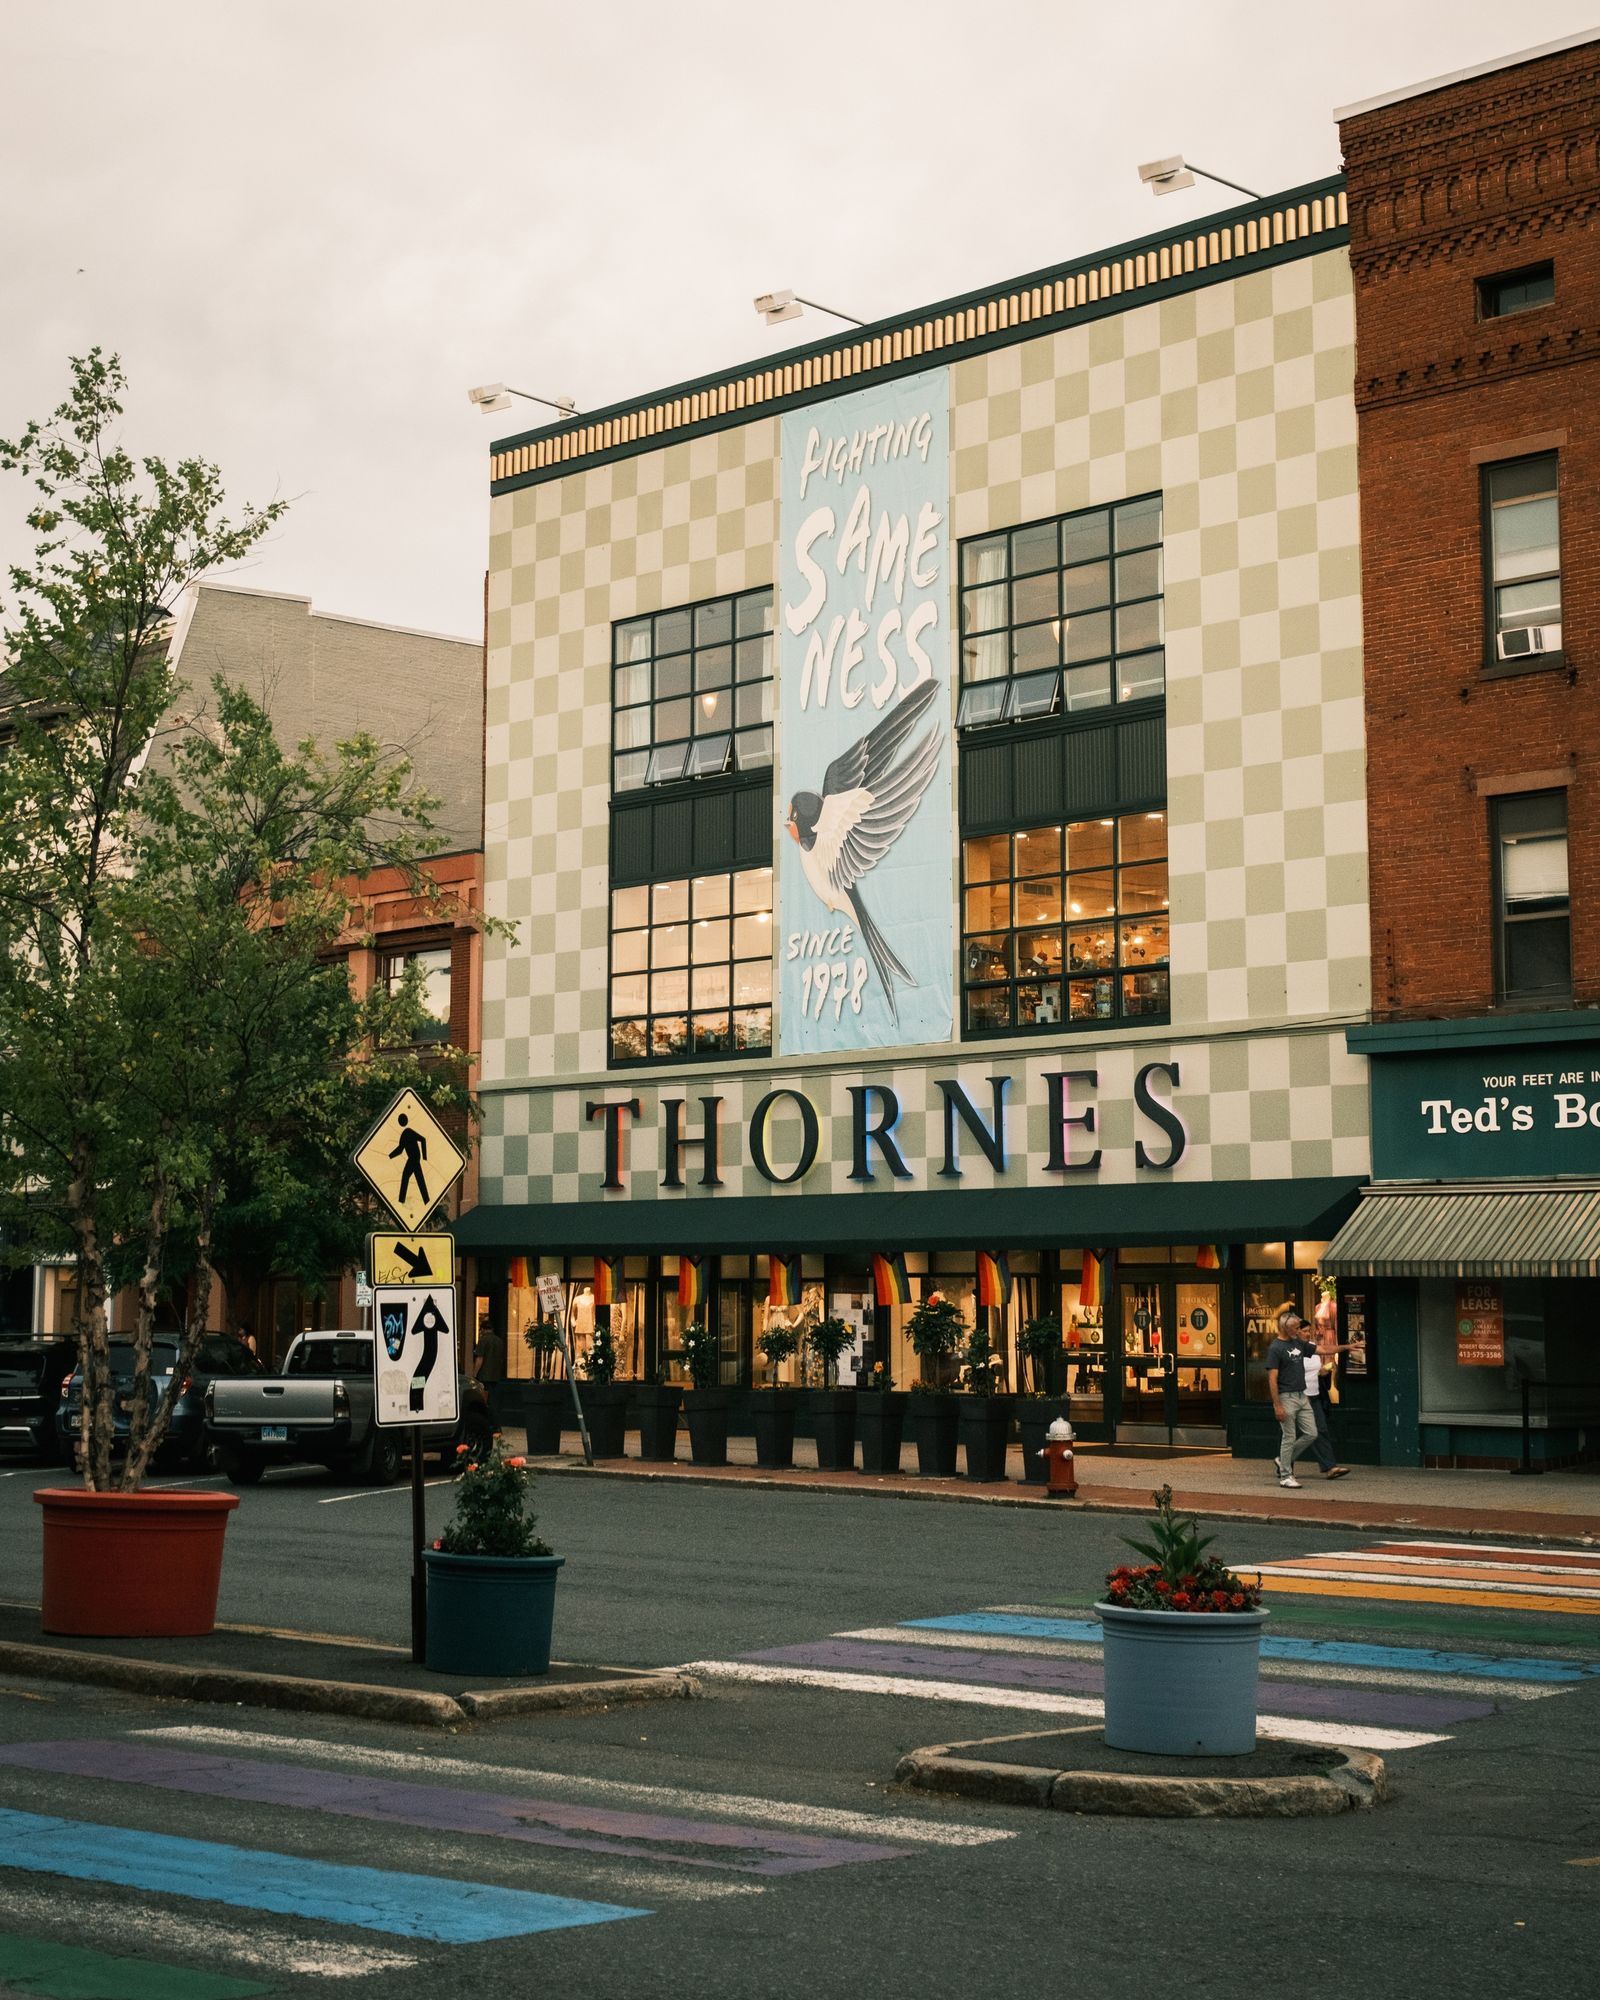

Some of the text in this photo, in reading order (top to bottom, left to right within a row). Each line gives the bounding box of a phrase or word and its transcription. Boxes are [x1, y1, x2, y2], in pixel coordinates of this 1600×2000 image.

[800, 411, 933, 500] FIGHTING
[785, 484, 944, 636] SAME
[800, 600, 939, 711] NESS
[786, 924, 855, 961] SINCE
[801, 956, 868, 1022] 1978
[1482, 1076, 1516, 1088] YOUR
[1522, 1073, 1554, 1086] FEET
[1559, 1071, 1585, 1084] ARE
[586, 1062, 1187, 1190] THORNES
[1421, 1097, 1535, 1135] Ted's
[539, 1286, 561, 1296] PARKING
[543, 1277, 553, 1286] NO
[1467, 1286, 1492, 1298] FOR
[1125, 1296, 1159, 1304] THORNE
[1461, 1298, 1498, 1311] LEASE
[1246, 1319, 1279, 1334] ATM
